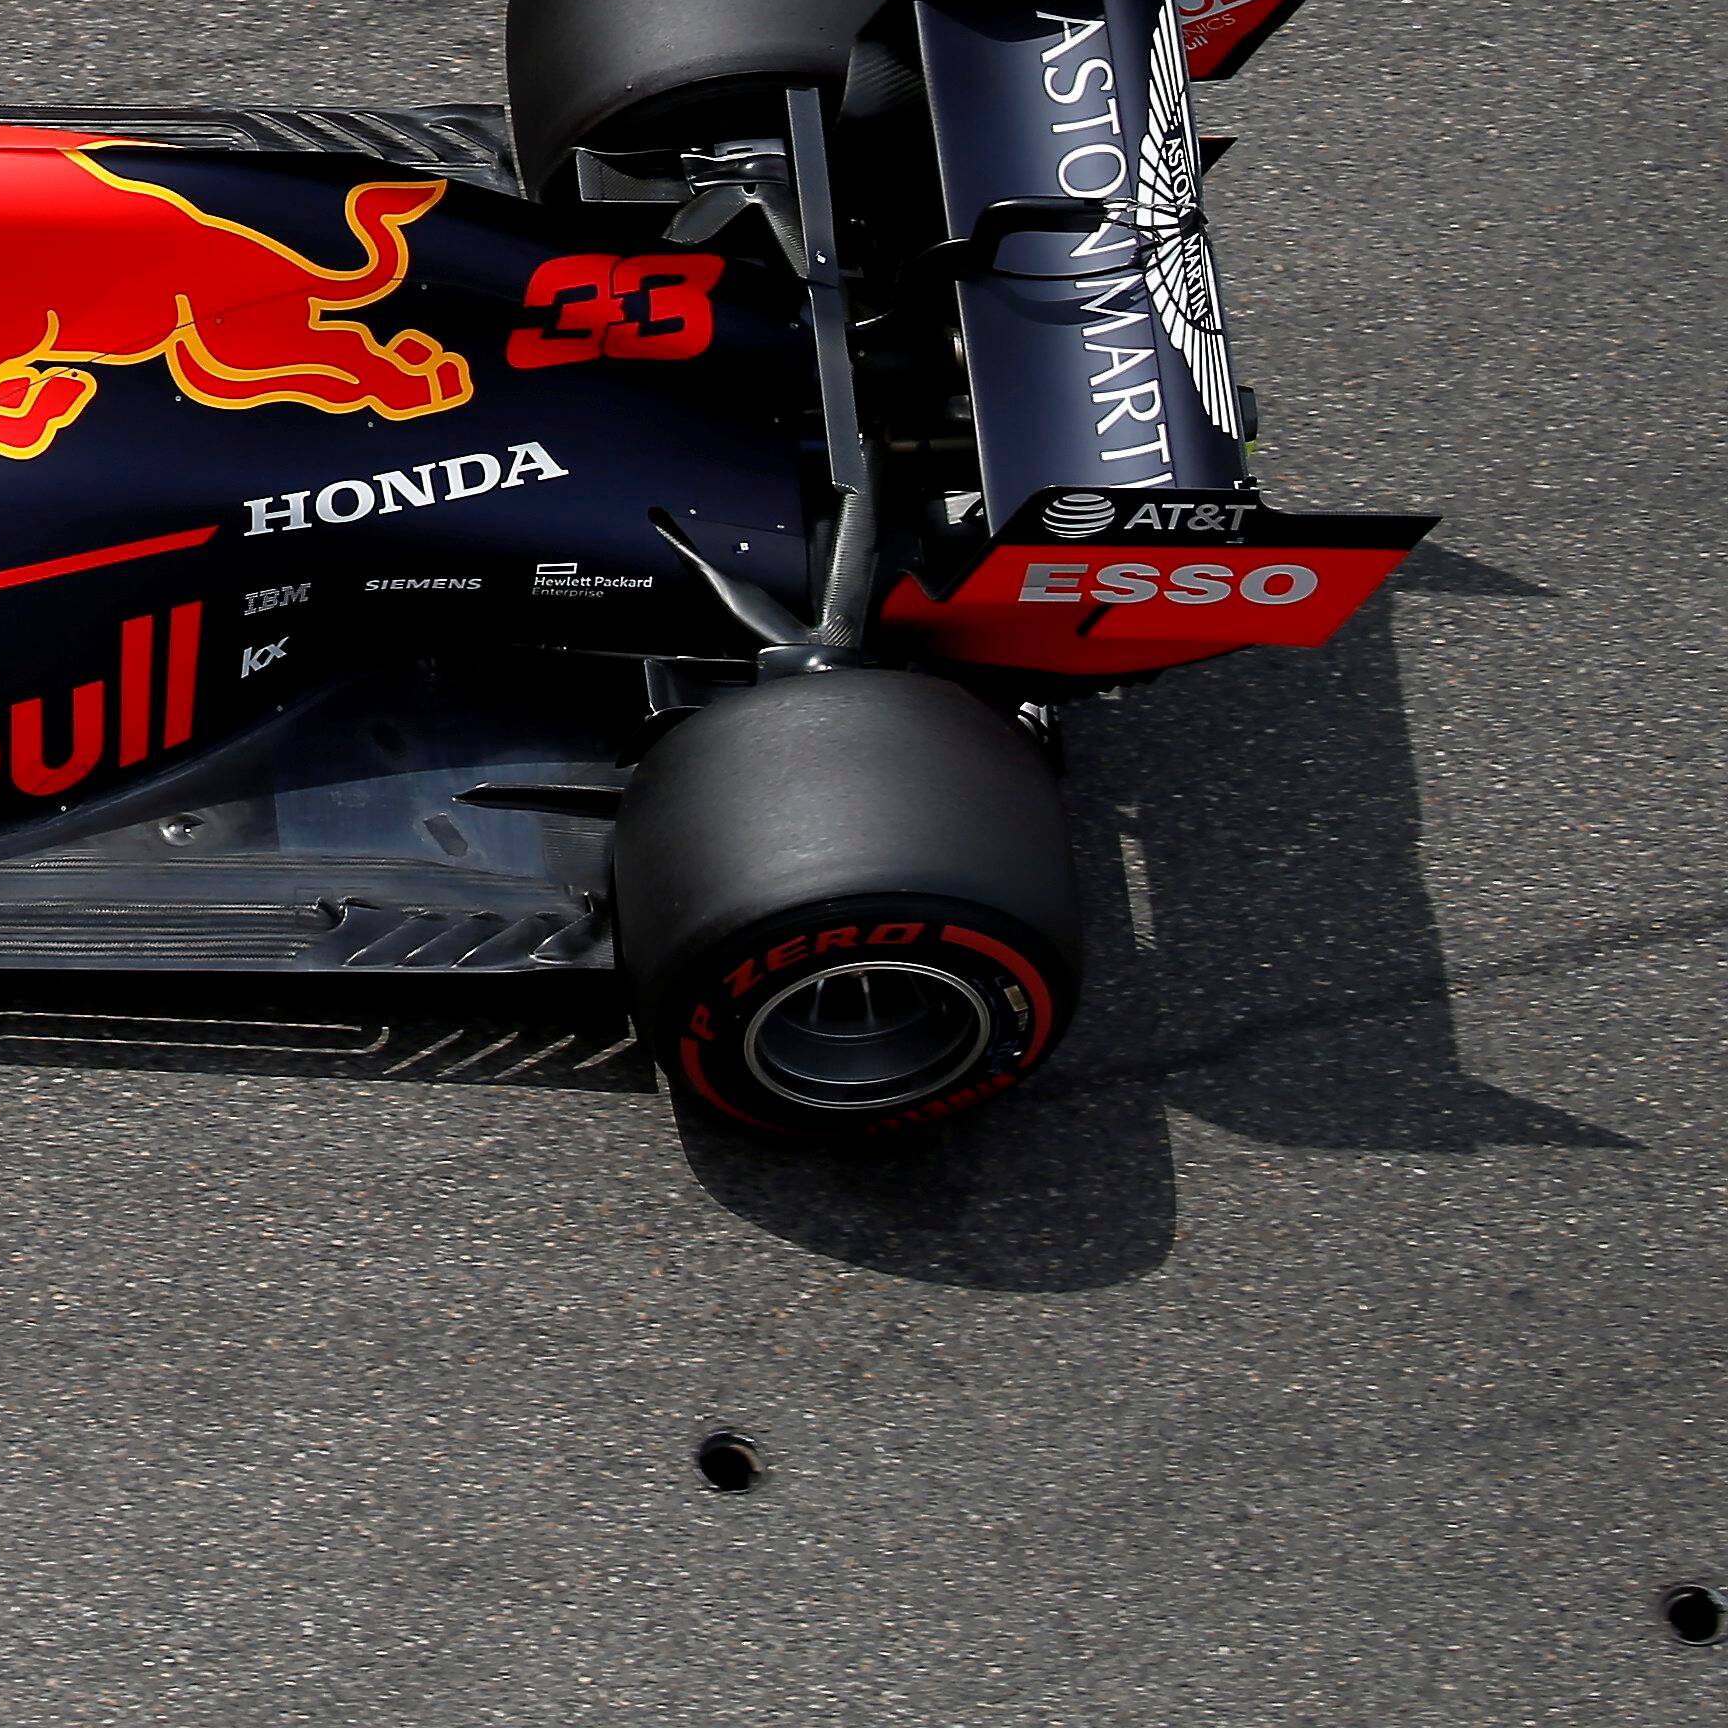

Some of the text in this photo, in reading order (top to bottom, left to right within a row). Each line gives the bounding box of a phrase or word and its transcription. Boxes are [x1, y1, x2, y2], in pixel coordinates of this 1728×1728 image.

[1186, 35, 1209, 51] ull
[1164, 136, 1208, 321] ASTON MARTIN
[505, 252, 726, 369] 33
[1074, 271, 1174, 489] MARTI
[243, 441, 570, 537] HONDA
[1123, 503, 1258, 531] AT&T
[244, 582, 312, 616] IBM
[364, 578, 483, 591] SIEMENS
[532, 586, 604, 598] Enterprise
[534, 575, 653, 588] Hewlett Packard
[1018, 563, 1319, 605] ESSO
[690, 922, 926, 1041] P ZERO
